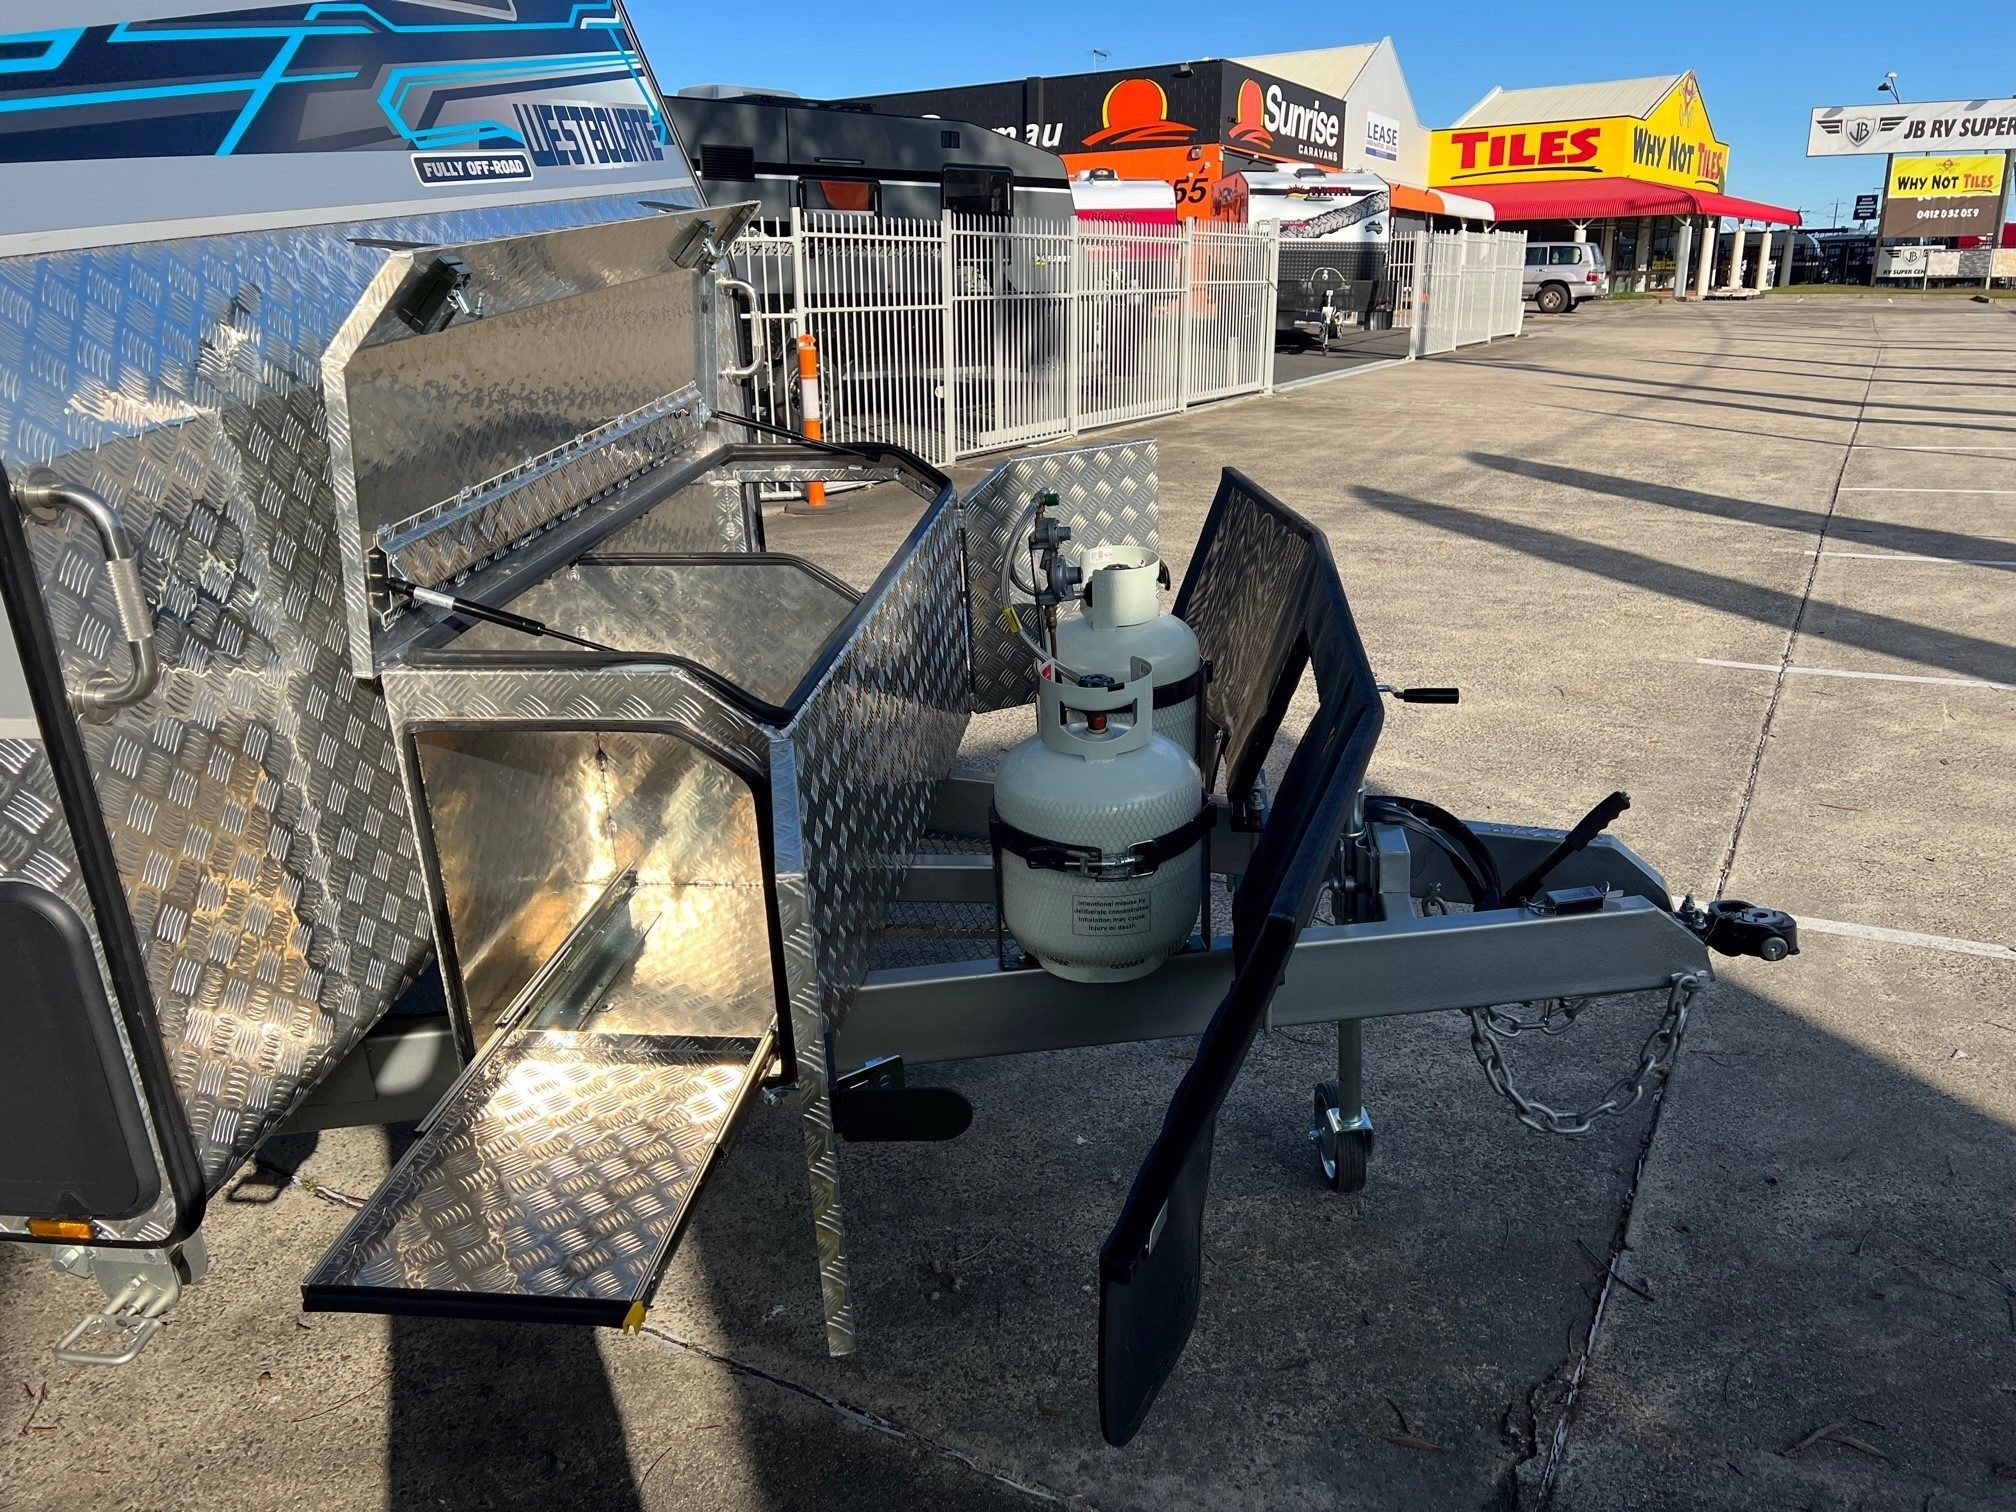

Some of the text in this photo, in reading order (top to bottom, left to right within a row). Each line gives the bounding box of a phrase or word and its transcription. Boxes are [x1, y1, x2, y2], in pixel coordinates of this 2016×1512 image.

[1264, 84, 1339, 147] Sunrise
[1903, 116, 2016, 139] JB RV SUPER
[512, 103, 664, 167] WESTBOURNE
[1367, 121, 1398, 146] LEASE
[1298, 144, 1338, 162] CARAVANS
[1451, 128, 1600, 170] TILES
[1633, 124, 1723, 180] WHY NOT TILES
[423, 159, 525, 177] FULLY OFF-ROAD
[1897, 173, 1994, 190] WHY NOT TILES
[1916, 209, 1940, 219] 0412
